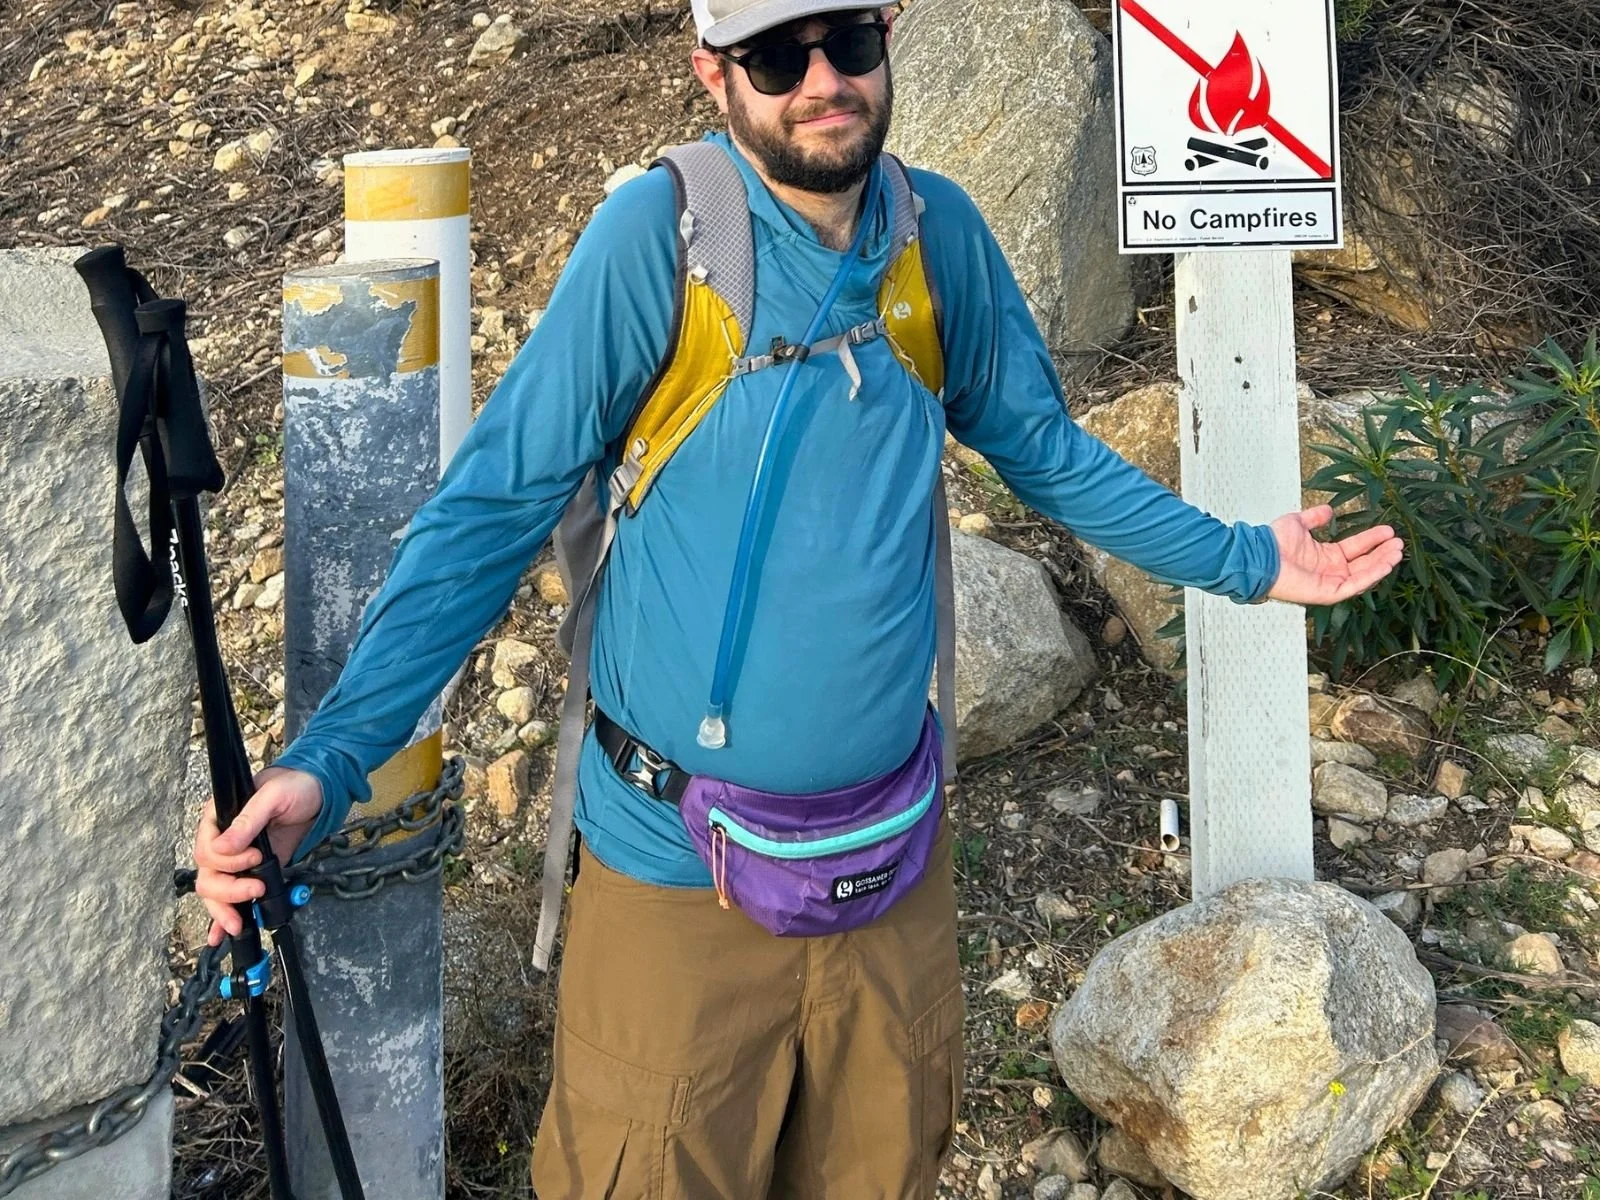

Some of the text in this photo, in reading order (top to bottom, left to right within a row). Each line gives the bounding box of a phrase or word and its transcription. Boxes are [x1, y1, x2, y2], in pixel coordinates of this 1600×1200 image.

[1143, 207, 1318, 233] No Campfires
[855, 872, 888, 888] GOSSAMER
